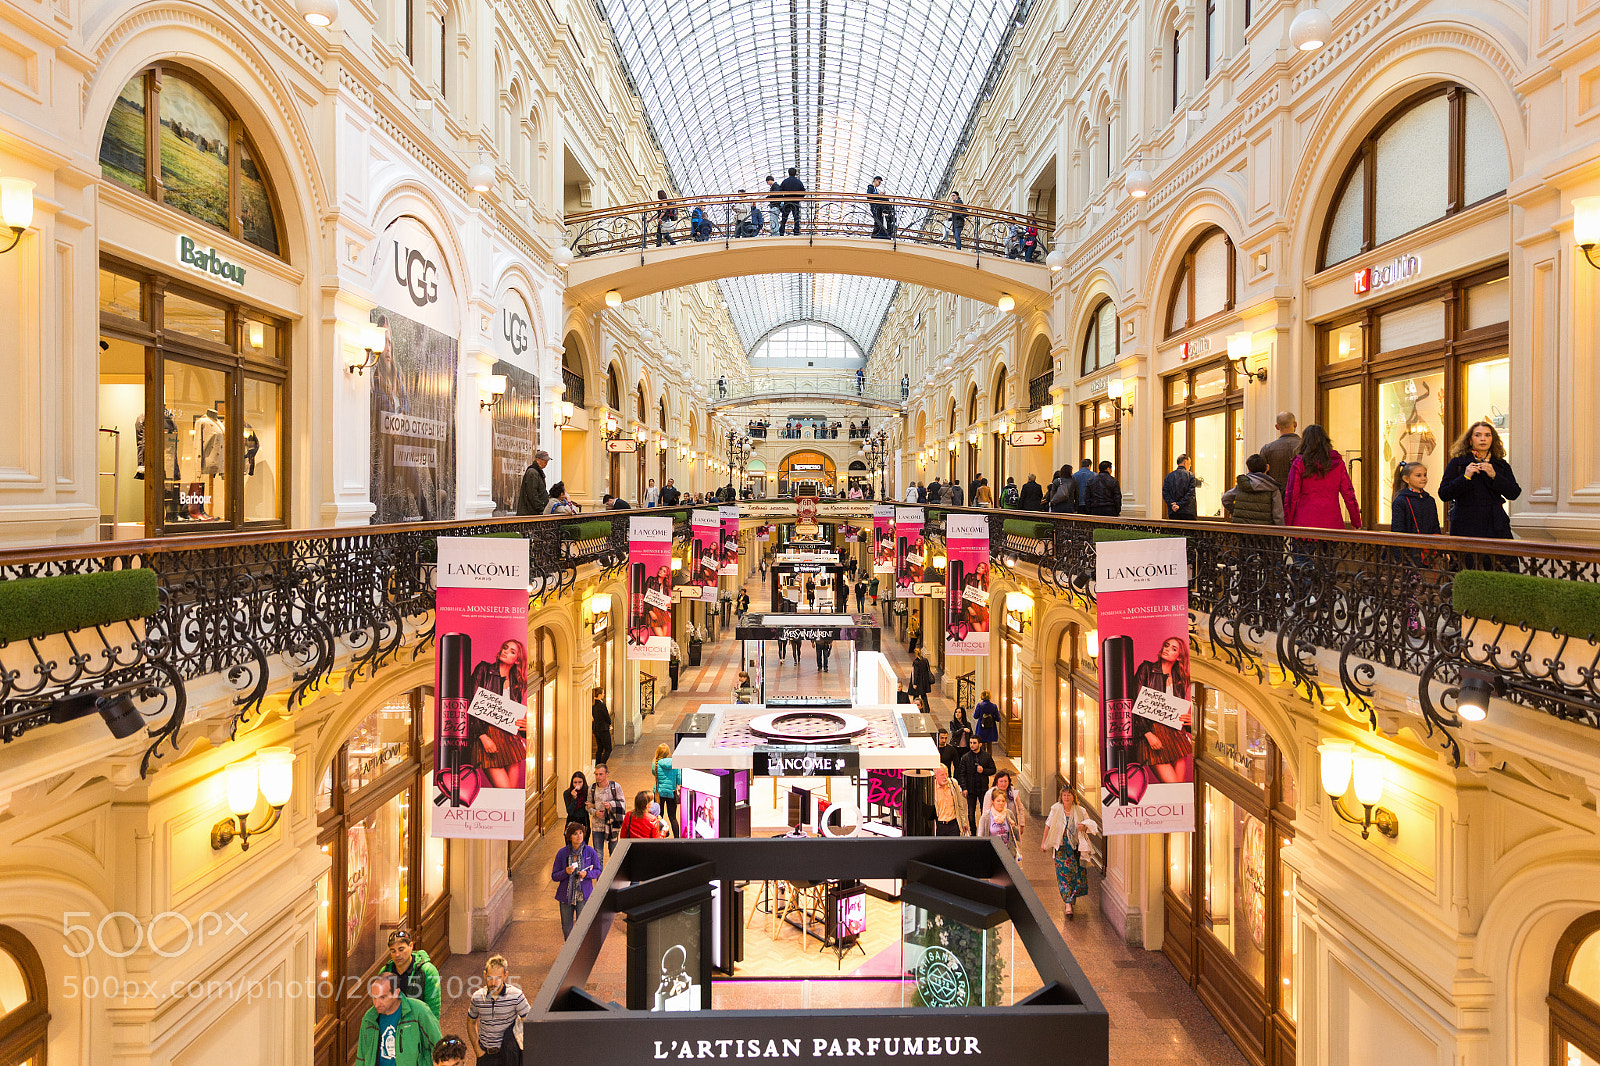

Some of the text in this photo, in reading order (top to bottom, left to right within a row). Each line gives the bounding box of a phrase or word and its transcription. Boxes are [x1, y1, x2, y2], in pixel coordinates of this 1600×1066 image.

[181, 236, 246, 286] Barbour
[393, 240, 438, 307] UGG
[503, 308, 528, 355] UGG
[384, 416, 410, 433] СКОРО
[180, 492, 212, 505] Barbour
[448, 562, 520, 577] LANCÔME
[1106, 563, 1178, 580] LANCÔME
[466, 605, 510, 613] MONSIEUR
[1127, 605, 1169, 614] MONSIEUR
[443, 701, 466, 710] MON
[1108, 702, 1131, 710] MON
[442, 711, 467, 719] SIEUR
[1108, 712, 1131, 720] SIEUR
[444, 809, 515, 822] ARTICOLI
[1113, 805, 1184, 819] ARTICOLI
[812, 1036, 982, 1057] PARFUMEUR
